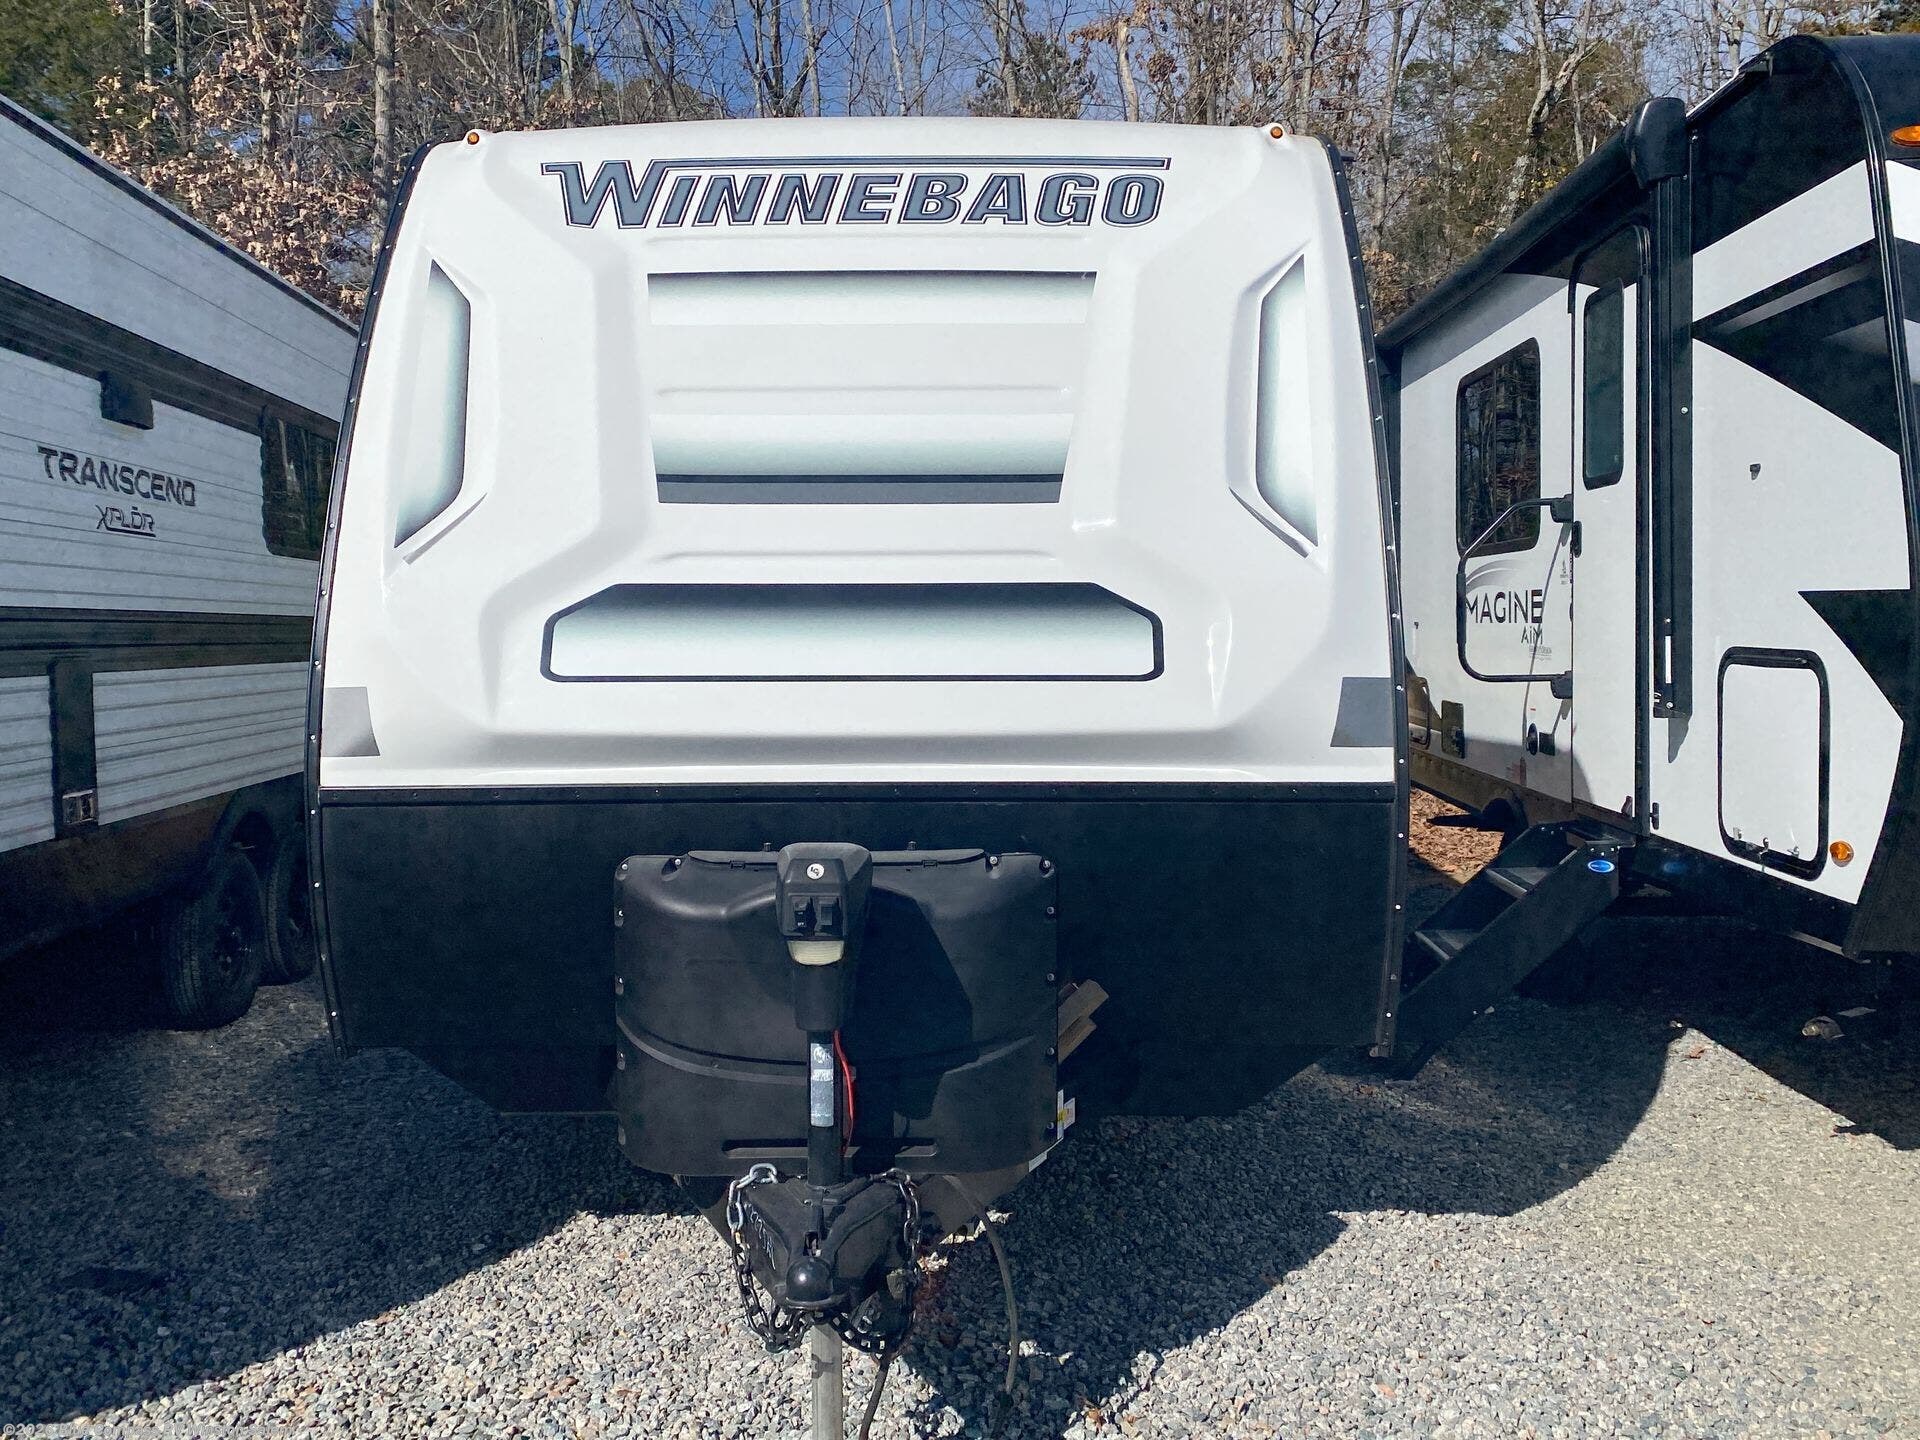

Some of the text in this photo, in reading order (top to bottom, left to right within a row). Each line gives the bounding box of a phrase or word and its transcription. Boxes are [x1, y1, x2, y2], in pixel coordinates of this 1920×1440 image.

[541, 155, 1172, 229] WINNEBAGO
[37, 445, 197, 507] TRANSCEND
[1465, 589, 1543, 623] MAGINE
